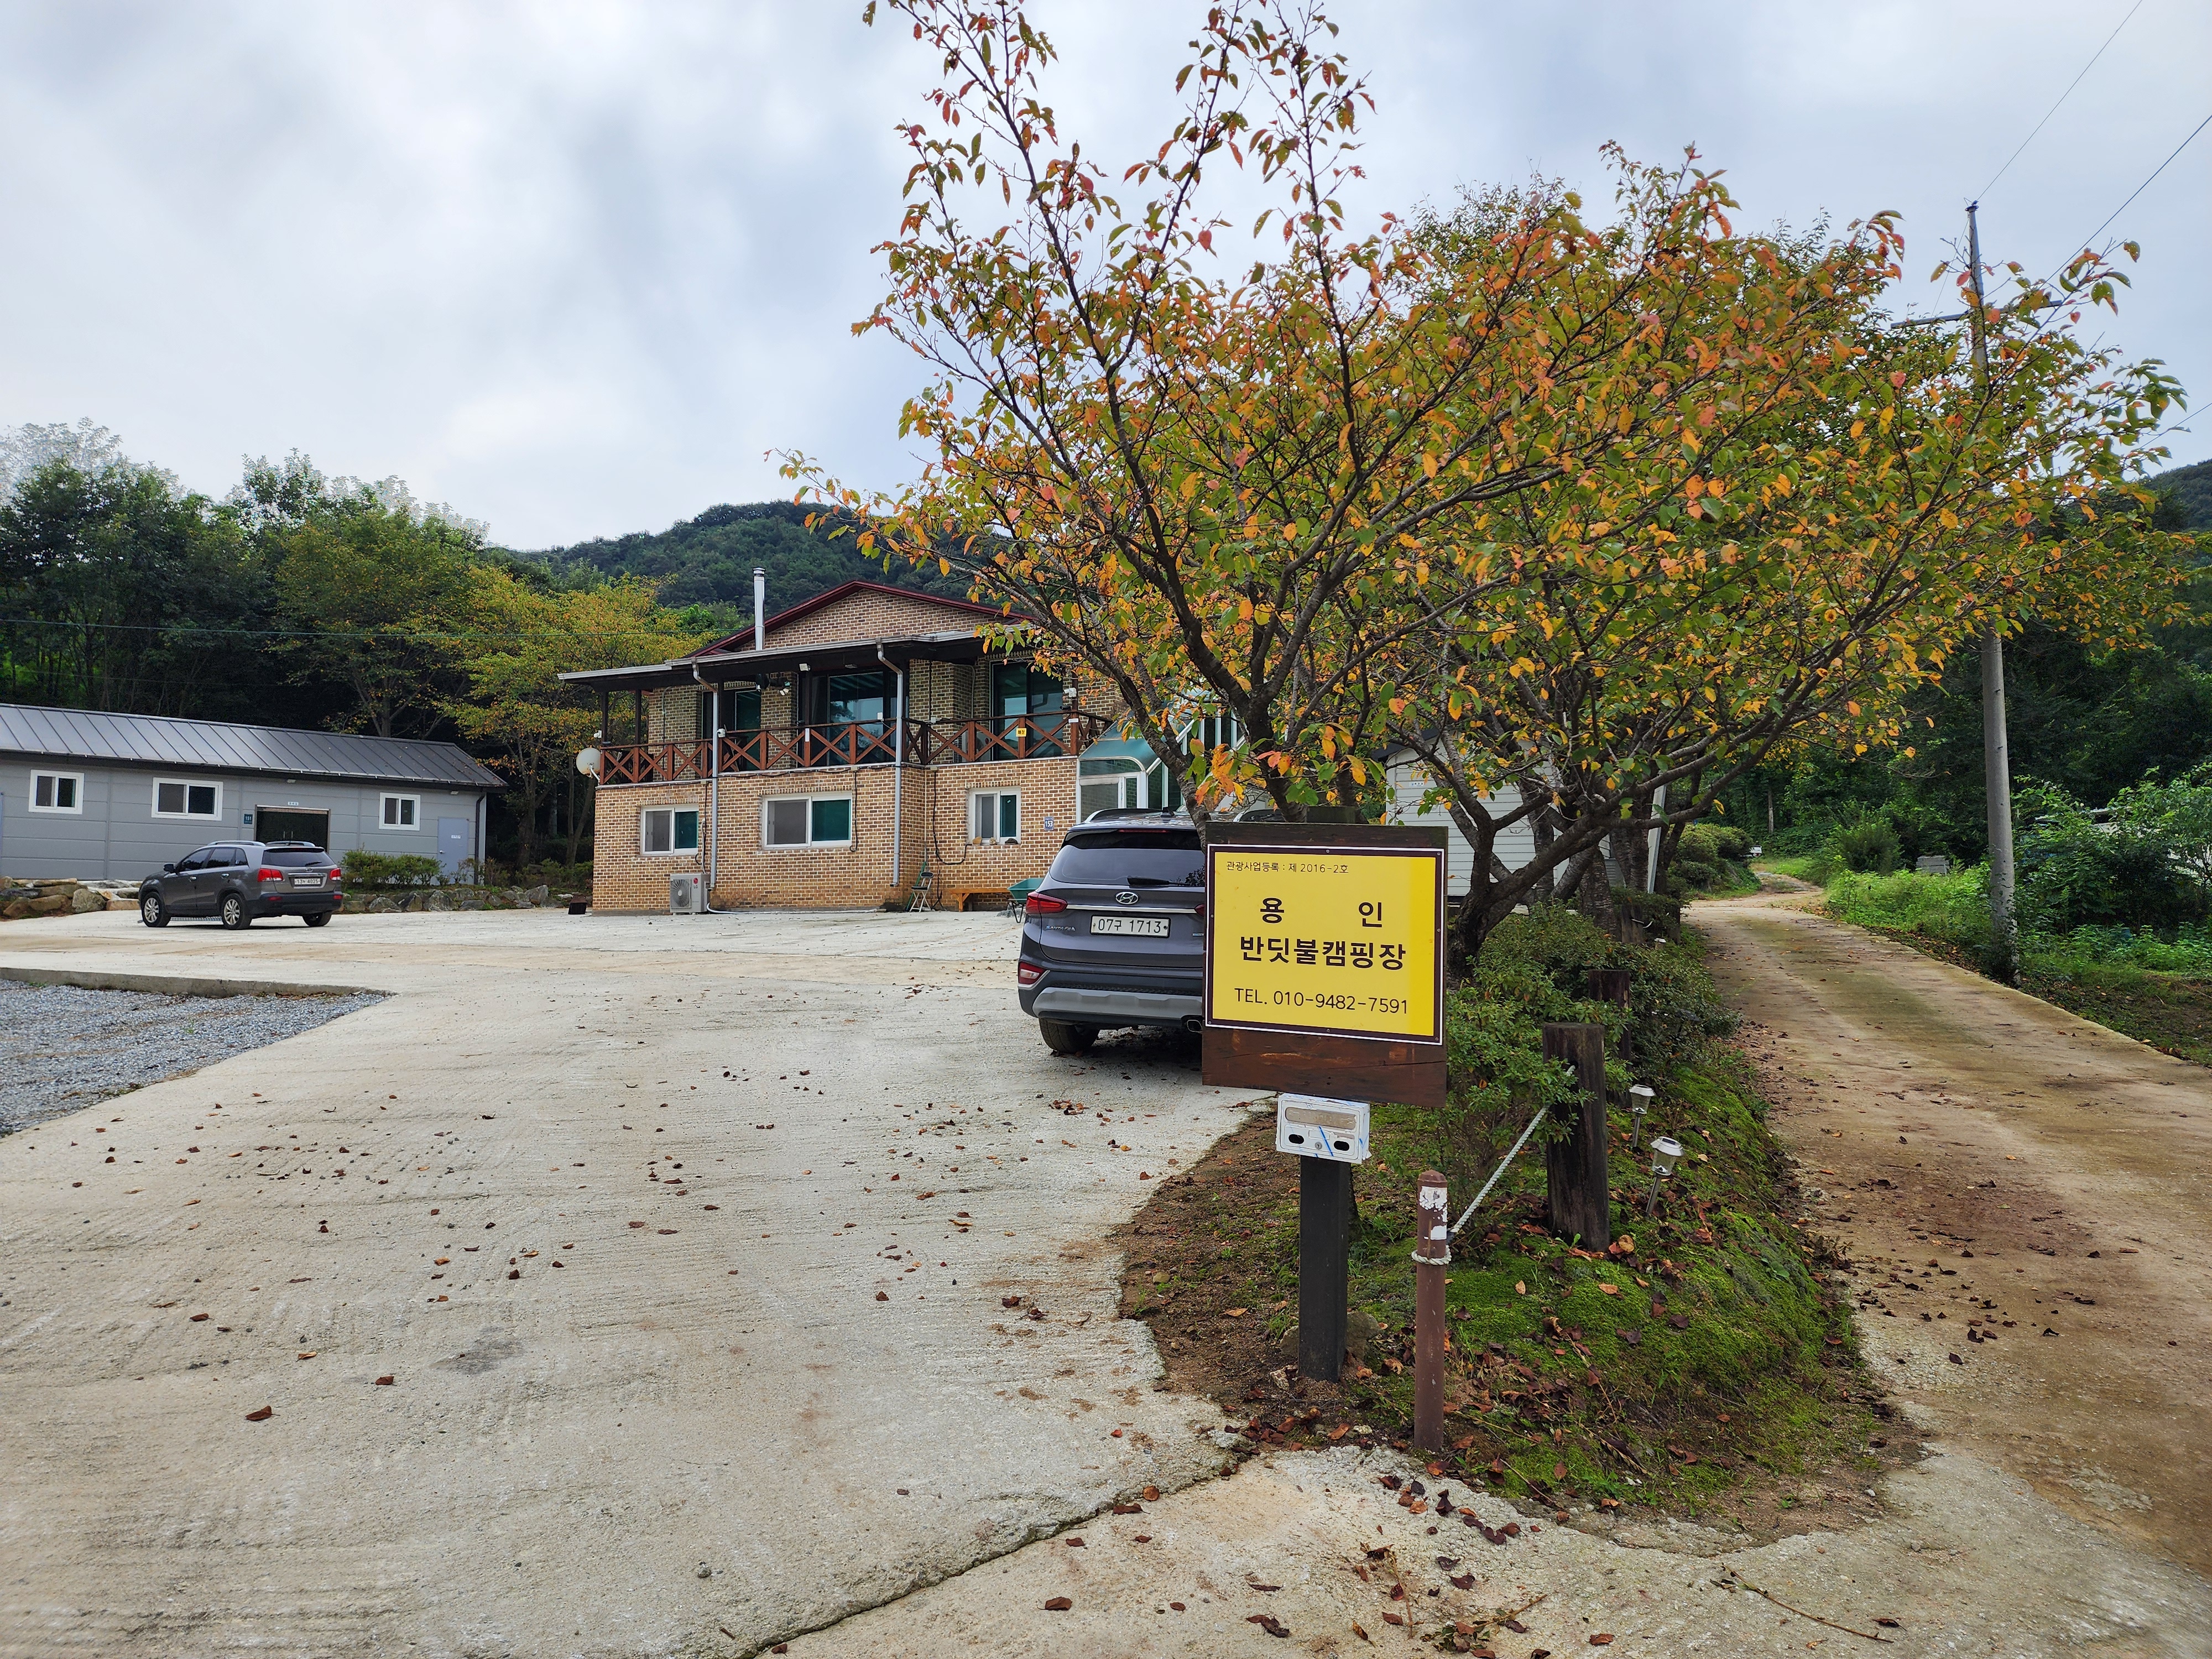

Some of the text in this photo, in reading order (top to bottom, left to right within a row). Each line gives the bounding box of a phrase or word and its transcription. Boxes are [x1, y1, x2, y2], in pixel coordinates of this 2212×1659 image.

[1226, 861, 1280, 872] 관광사업등록
[1288, 863, 1297, 873] 제
[1300, 863, 1349, 874] 2016-2호
[1260, 897, 1383, 928] 용 인
[1098, 919, 1161, 933] 07구 1713
[1240, 936, 1406, 971] 반딧불캠핑장
[1234, 988, 1407, 1014] TEL. 010-9482-7591
